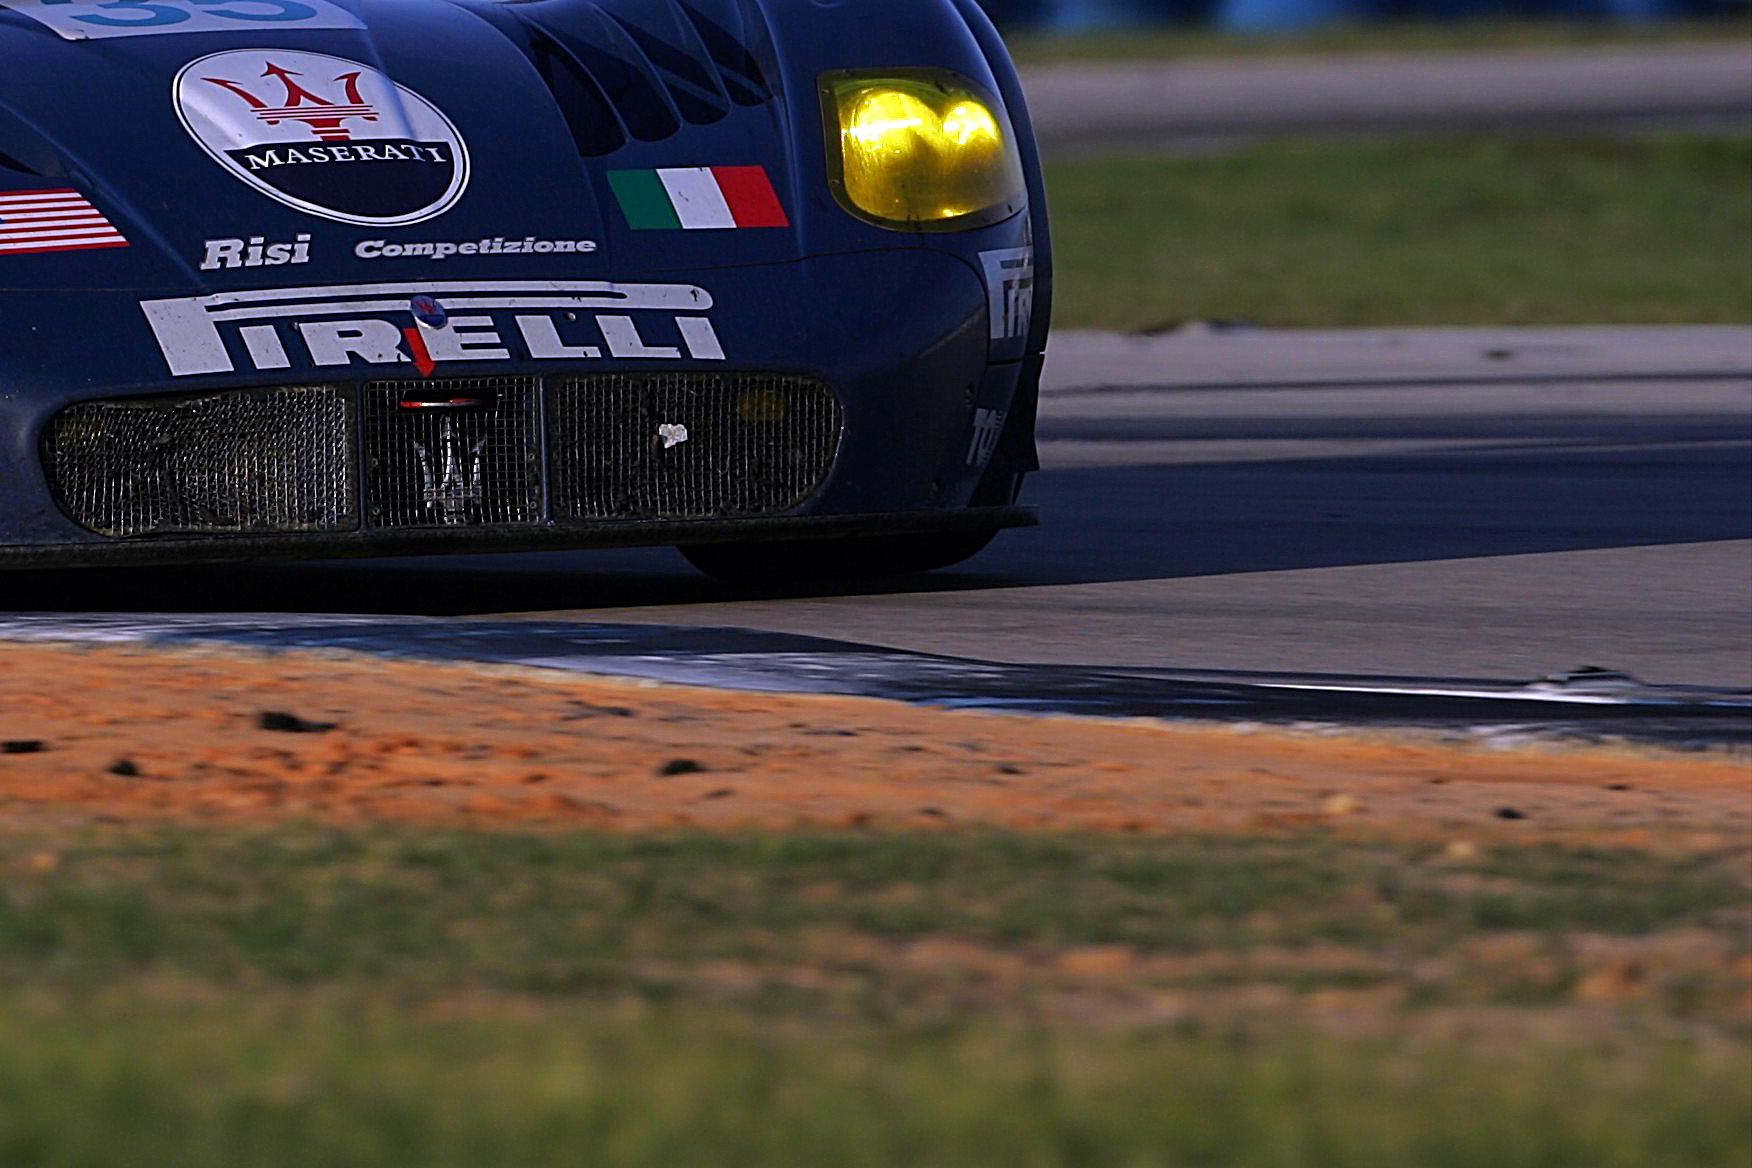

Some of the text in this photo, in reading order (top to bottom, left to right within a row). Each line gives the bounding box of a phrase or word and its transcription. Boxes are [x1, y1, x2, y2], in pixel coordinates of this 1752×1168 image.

[244, 143, 447, 170] MASERATI
[200, 234, 598, 270] Risi Competizione
[139, 280, 726, 376] PIRELLI
